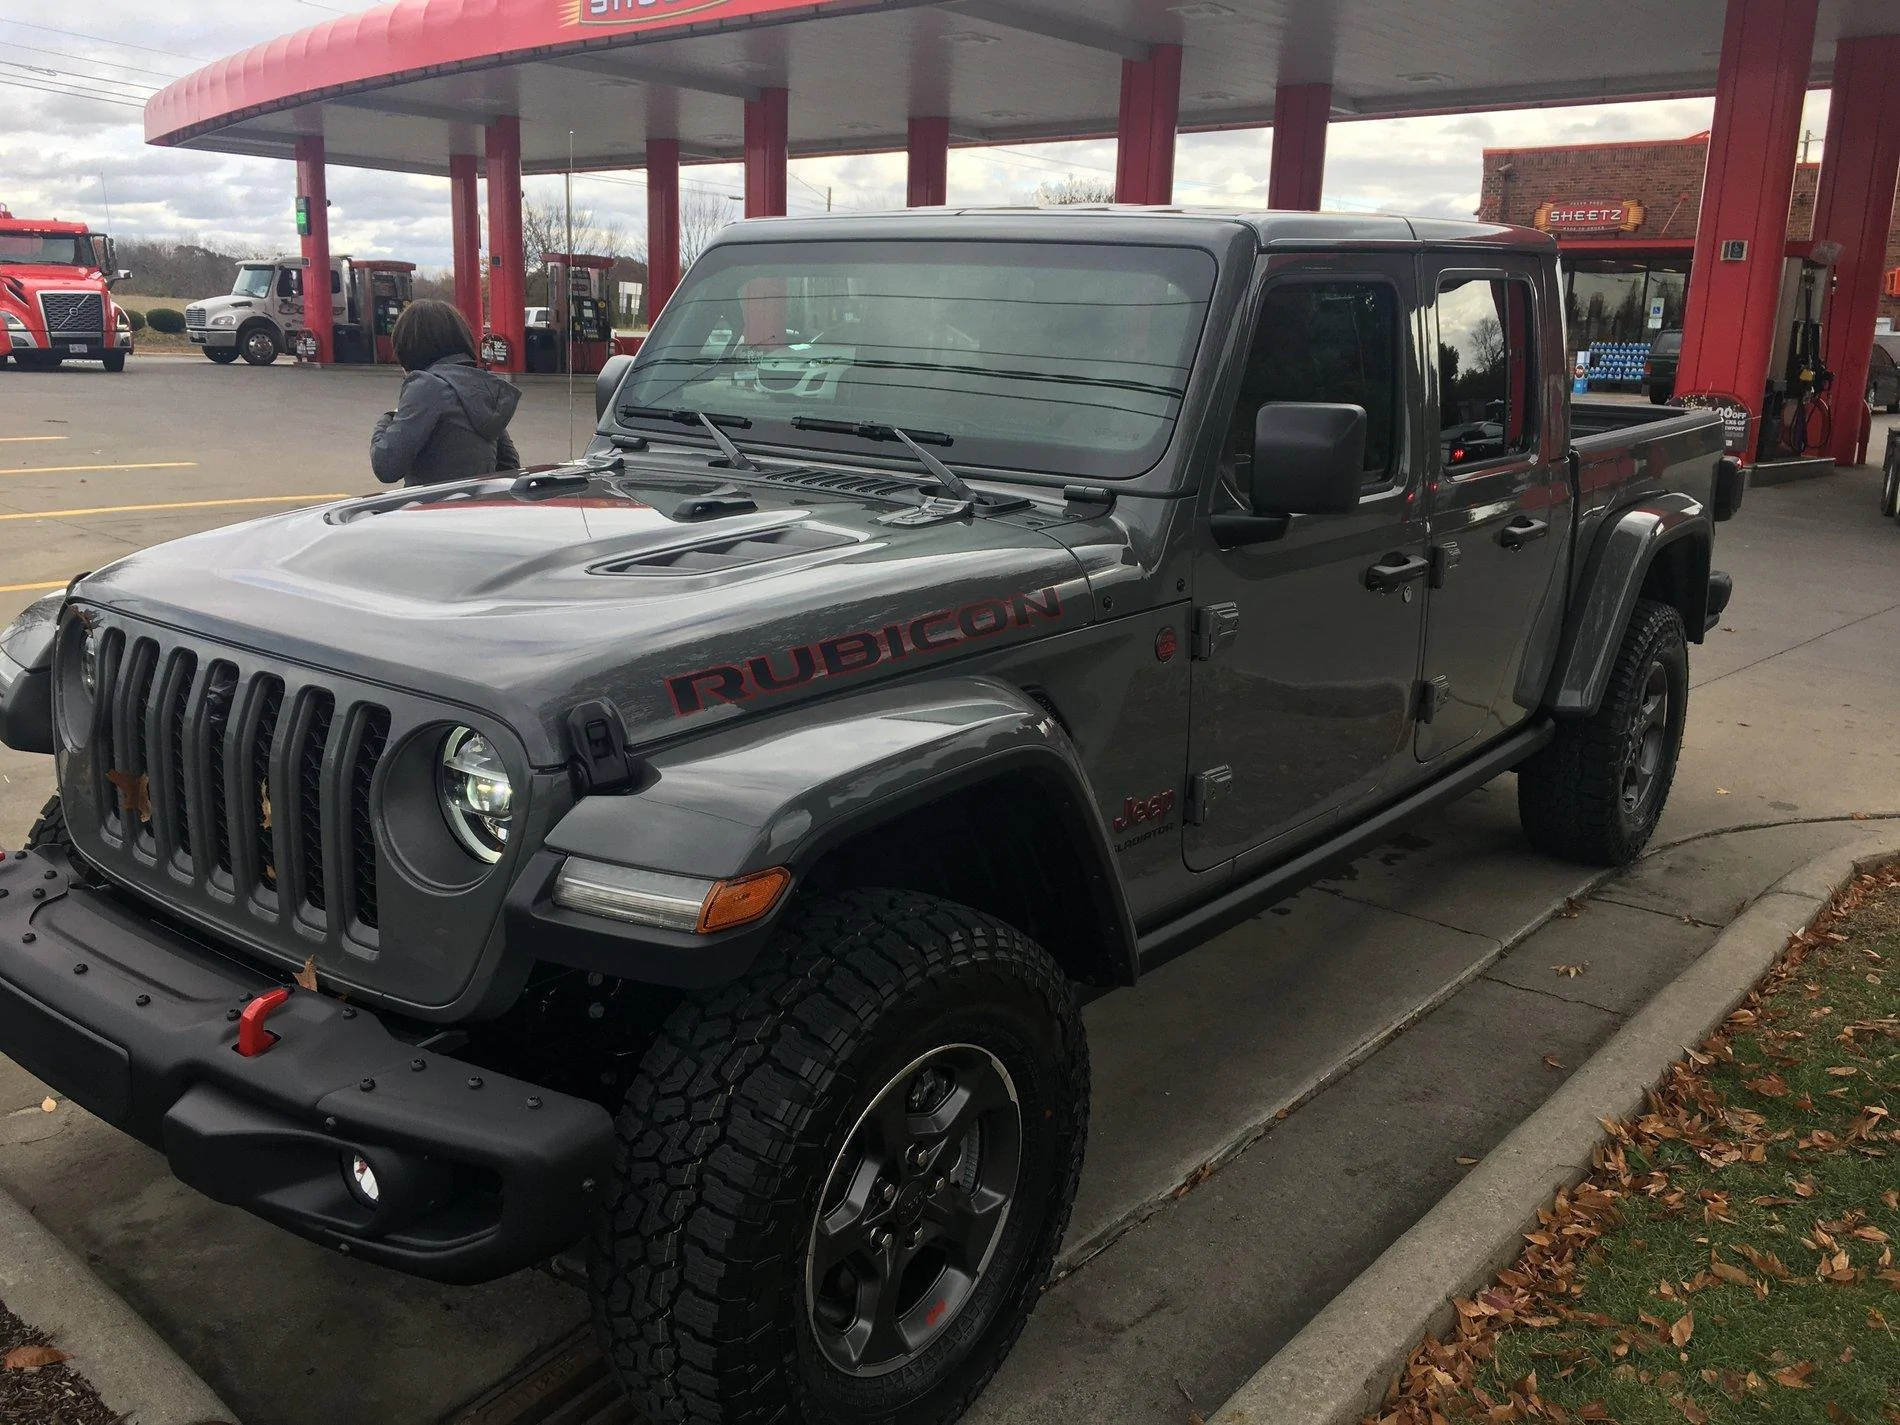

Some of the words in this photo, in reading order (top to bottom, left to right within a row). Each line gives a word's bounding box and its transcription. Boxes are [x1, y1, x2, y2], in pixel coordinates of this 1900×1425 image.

[1550, 209, 1622, 222] SHEETZ
[665, 585, 1066, 718] RUBICON
[1111, 788, 1175, 834] Jeep
